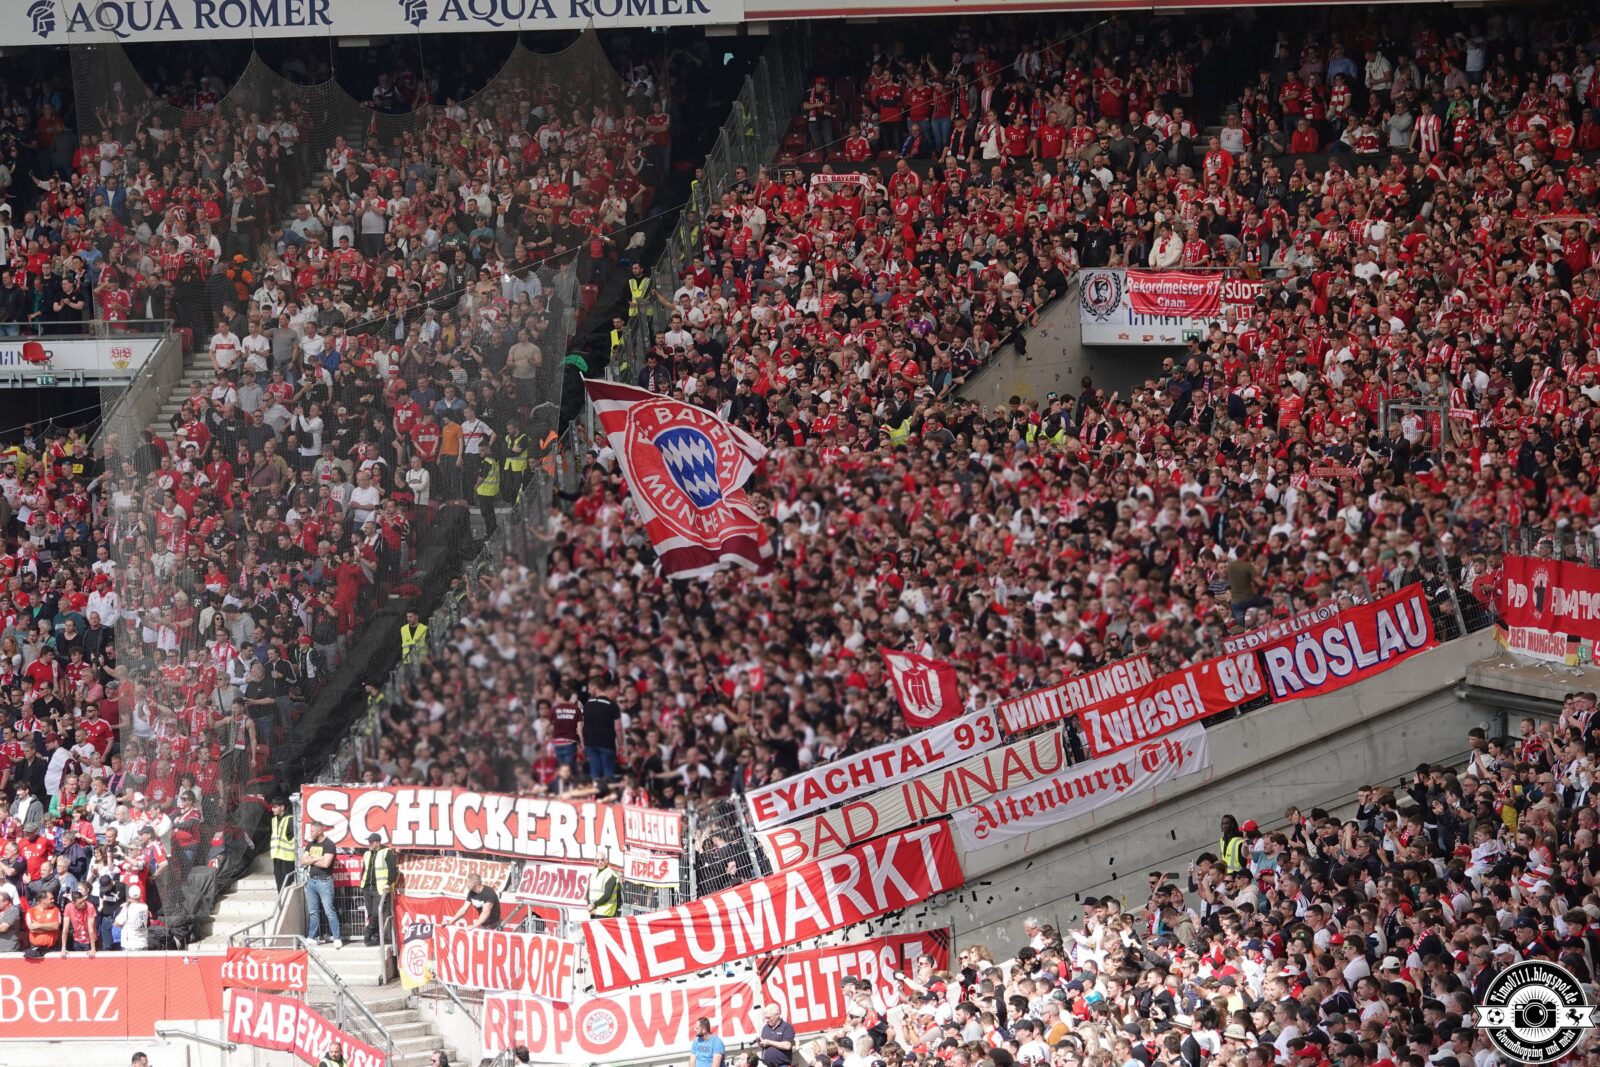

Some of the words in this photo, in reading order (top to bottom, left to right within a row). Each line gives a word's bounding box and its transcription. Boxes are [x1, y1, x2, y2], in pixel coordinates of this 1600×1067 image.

[65, 0, 183, 38] AQUA
[1127, 276, 1204, 296] Rekordmeister
[653, 406, 735, 480] BAYERN
[641, 474, 738, 534] MÜNCHEN
[1264, 596, 1428, 698] RÖSLAU
[1000, 659, 1153, 733] WINTERLINGEN
[751, 738, 946, 822] EYACHTAL
[953, 716, 995, 751] 93
[767, 801, 879, 871] BAD
[902, 732, 1063, 822] IMNAU
[969, 762, 1134, 840] Altenburg
[304, 788, 625, 867] SCHICKERIA
[519, 864, 593, 901] alarMs
[588, 825, 945, 987] NEUMARKT
[0, 975, 120, 1023] Benz
